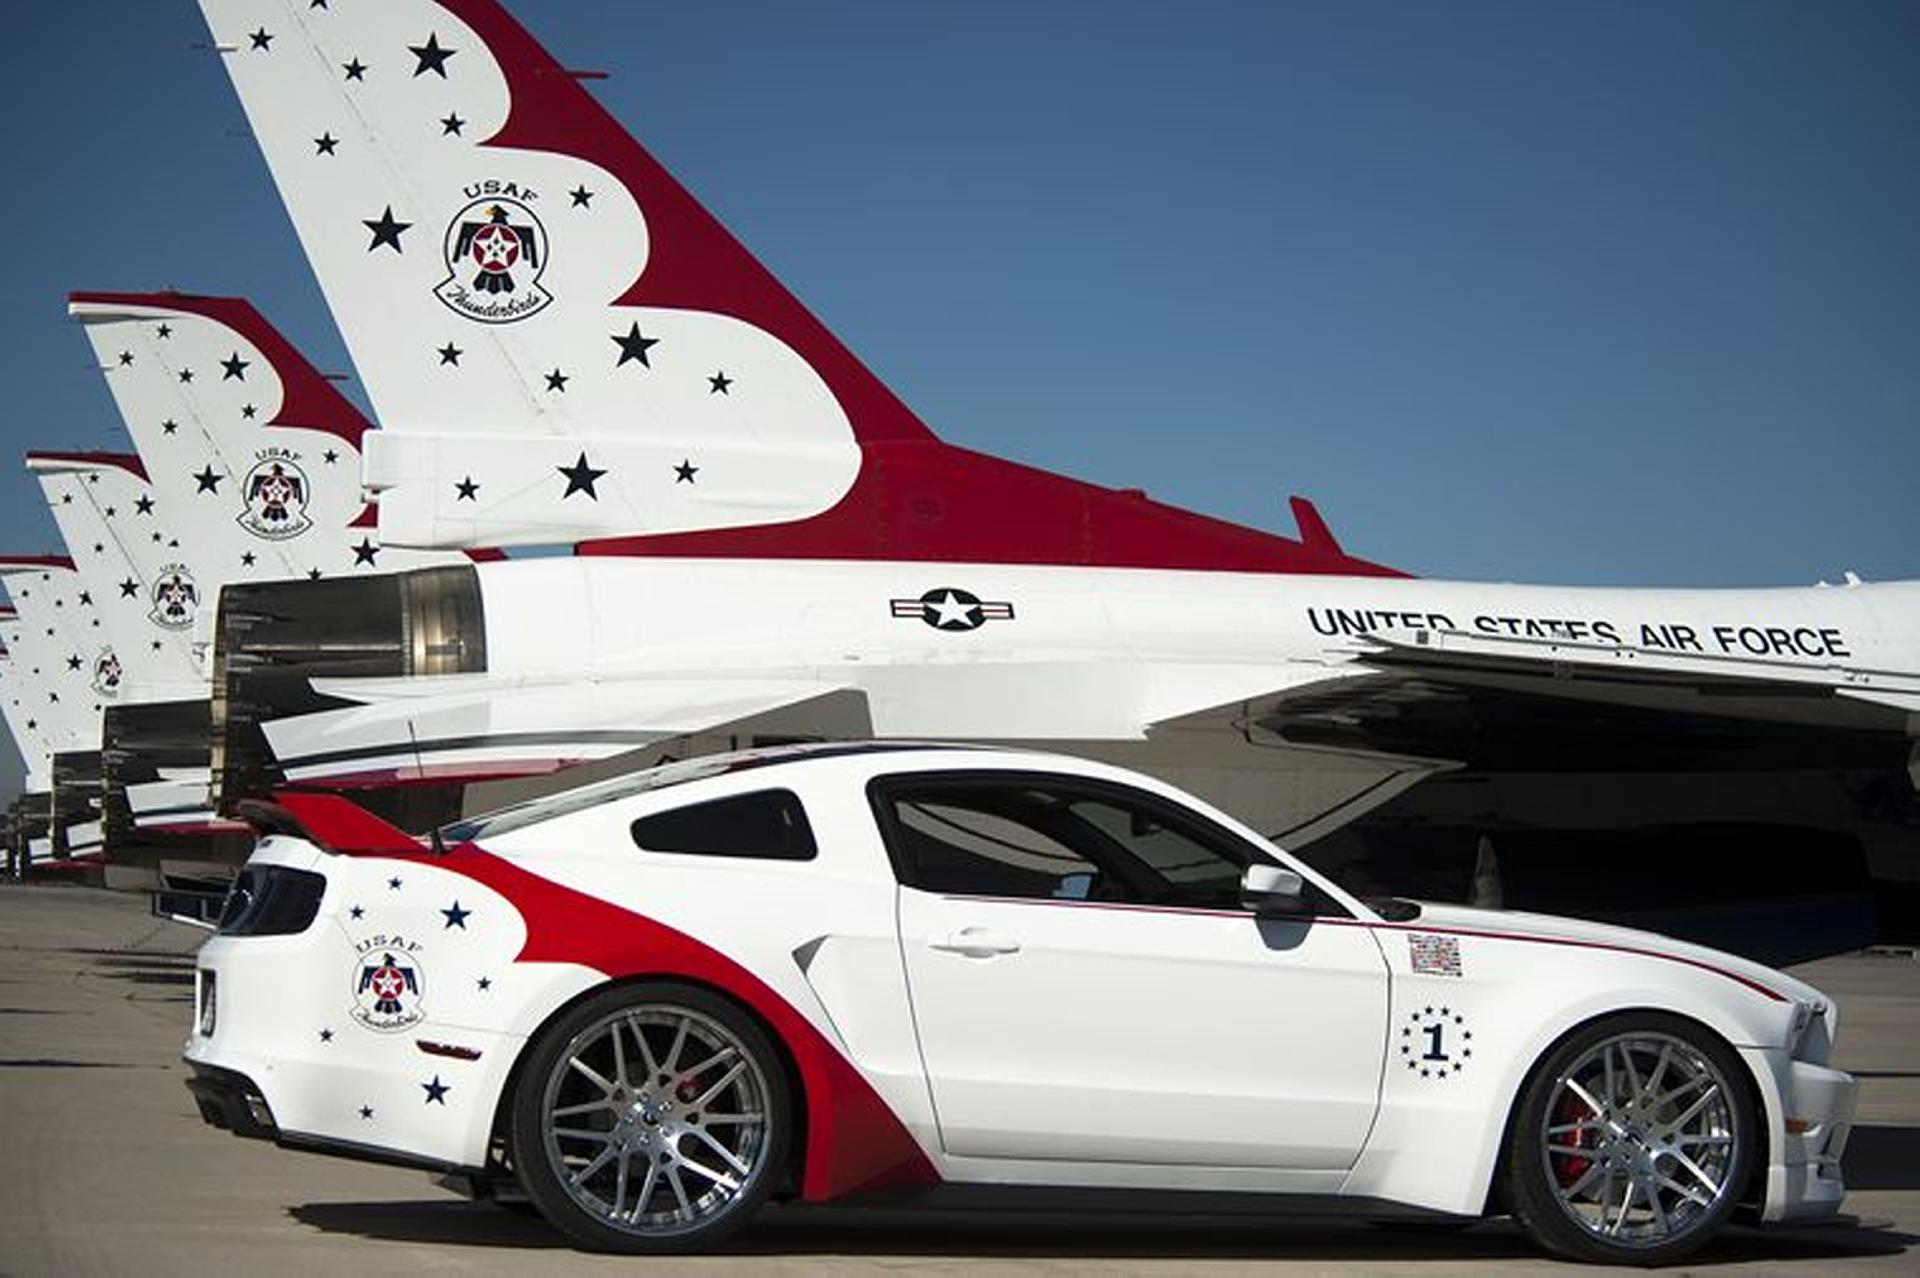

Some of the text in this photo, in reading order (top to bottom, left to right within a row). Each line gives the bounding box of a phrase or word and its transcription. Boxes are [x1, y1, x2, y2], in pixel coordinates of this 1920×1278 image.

[463, 179, 538, 201] USAF
[446, 283, 540, 317] Thunderbirds
[1307, 607, 1456, 636] UNITED
[1639, 623, 1704, 651] AIR
[1712, 626, 1851, 657] FORCE
[356, 934, 424, 952] USAF
[1422, 1022, 1449, 1062] 1
